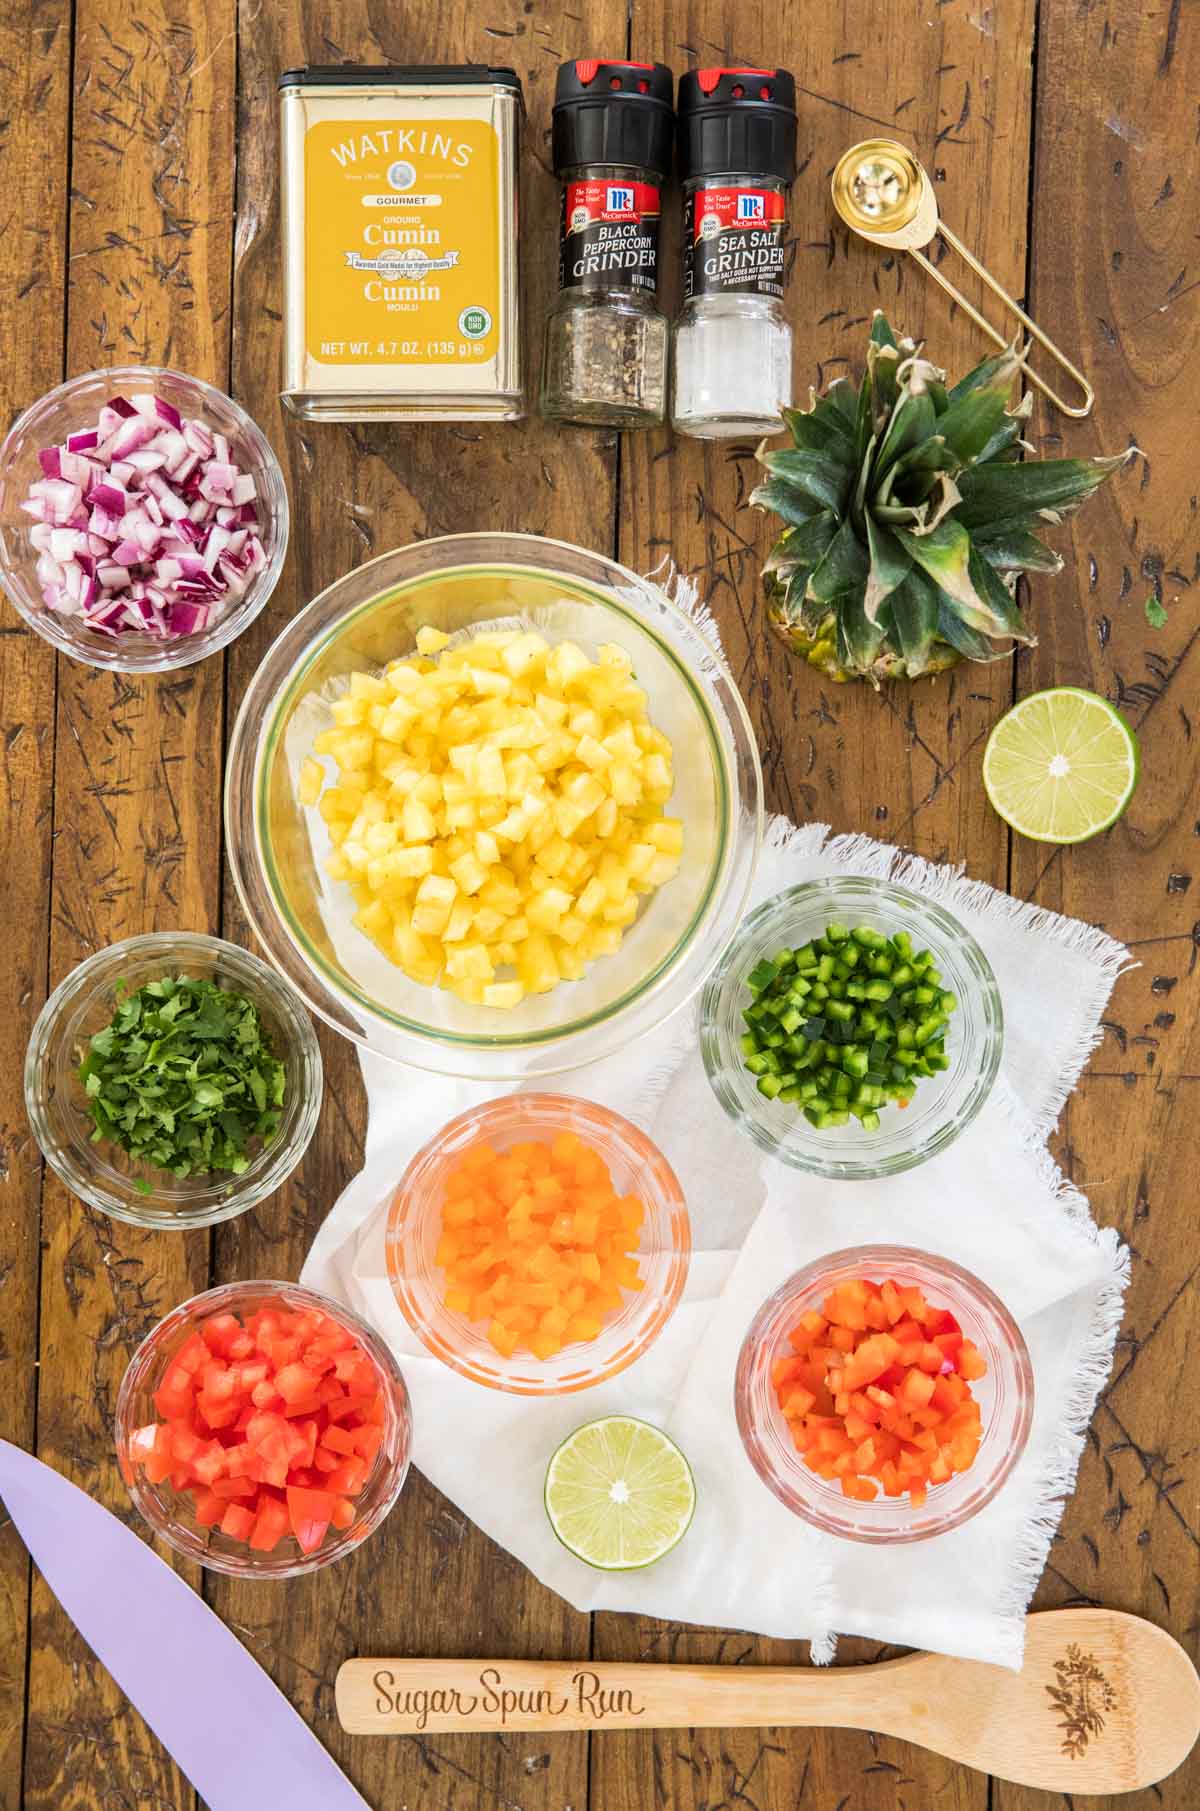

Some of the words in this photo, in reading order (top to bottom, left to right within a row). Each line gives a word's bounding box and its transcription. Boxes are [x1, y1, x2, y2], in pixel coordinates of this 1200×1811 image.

[330, 128, 473, 168] WATKINS
[376, 197, 428, 206] GOURMET
[383, 215, 422, 224] GROUND
[363, 223, 441, 246] Cumin
[598, 224, 638, 241] BLACK
[718, 235, 747, 253] SEA
[749, 231, 778, 247] SALT
[583, 236, 652, 258] PEPPERCORN
[572, 249, 656, 278] GRINDER
[703, 247, 784, 276] GRINDER
[363, 280, 441, 302] Cumin
[320, 342, 346, 355] NET
[349, 342, 374, 357] WT.
[376, 342, 397, 355] 4.7
[427, 341, 456, 357] (135
[373, 1670, 478, 1730] Sugar
[479, 1668, 569, 1725] Spun
[572, 1671, 646, 1720] Run
